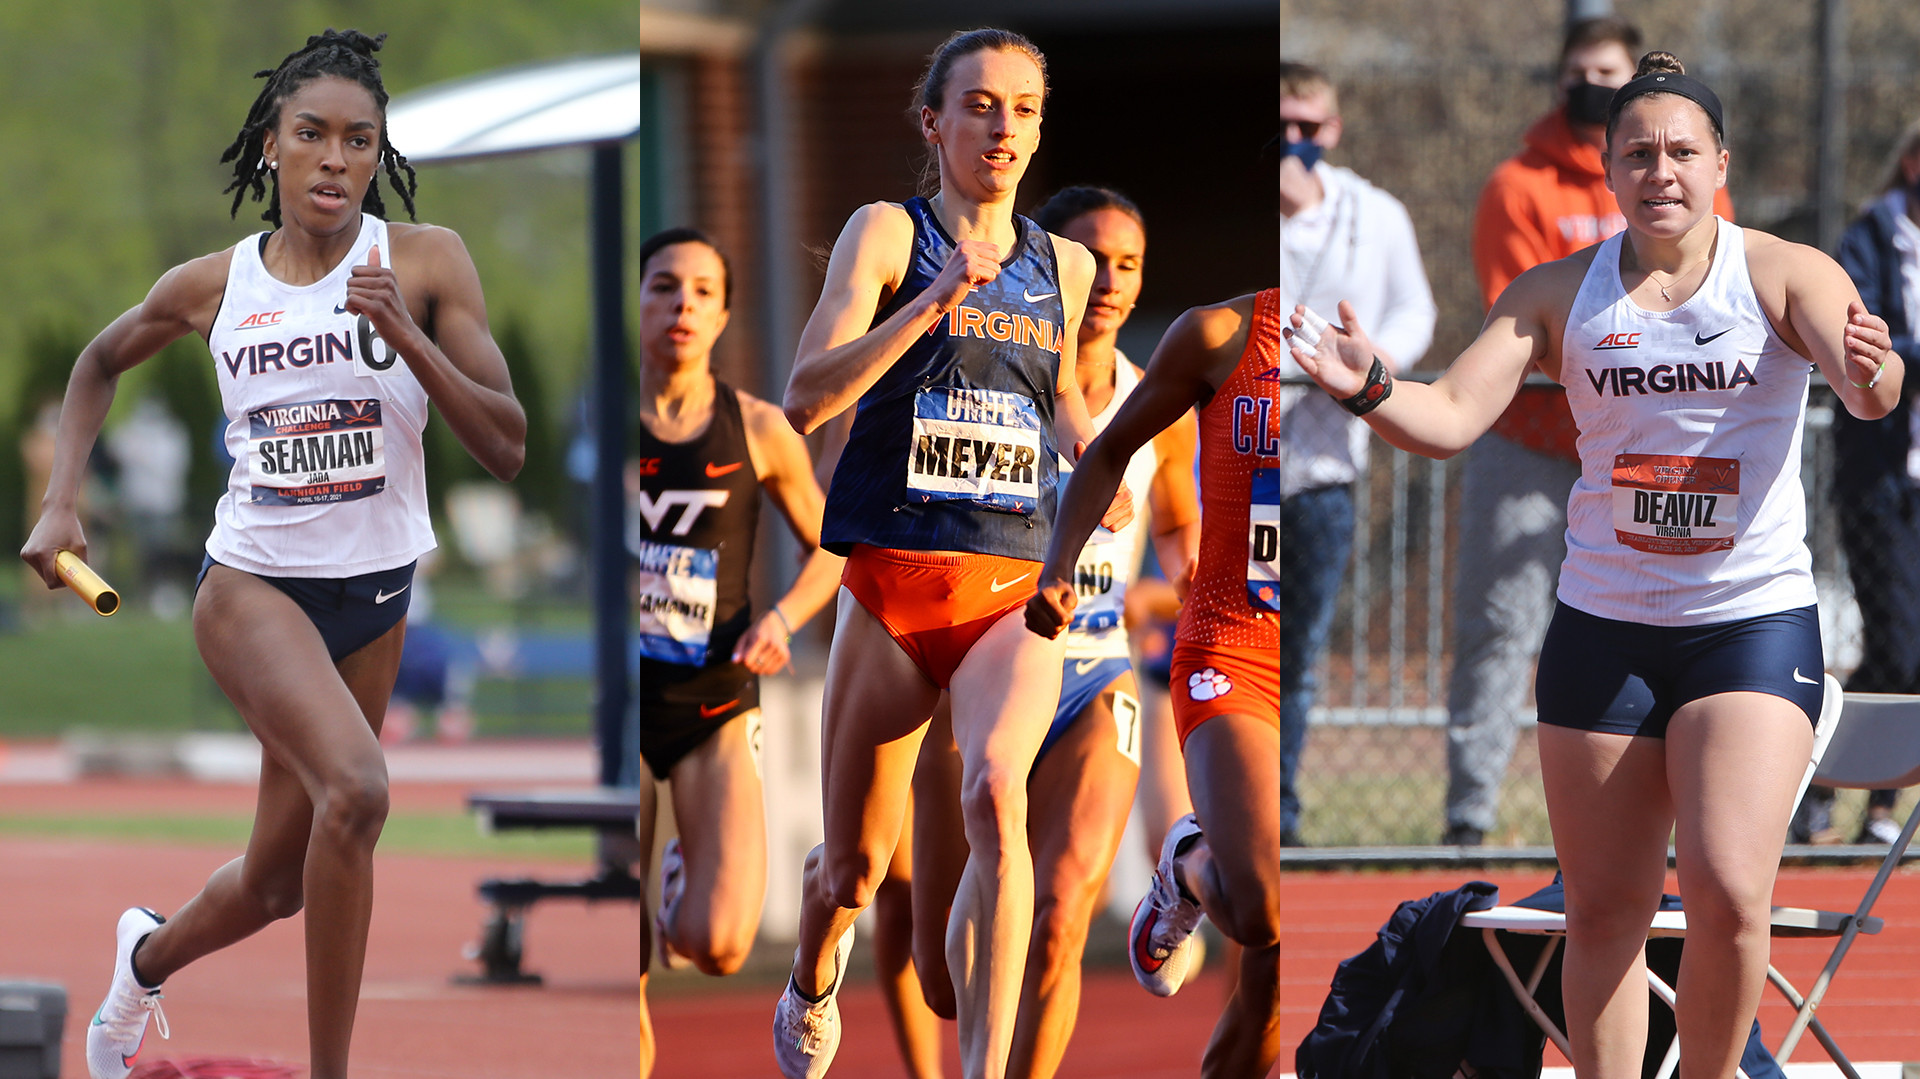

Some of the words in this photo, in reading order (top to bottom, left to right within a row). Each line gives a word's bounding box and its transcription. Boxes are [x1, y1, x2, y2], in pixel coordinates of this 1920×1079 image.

[238, 310, 285, 328] ACC
[357, 314, 397, 371] 6
[1596, 332, 1642, 347] ACC
[1585, 359, 1758, 398] VIRGINIA
[260, 403, 342, 428] VIRGINIA
[946, 389, 1015, 425] UNITE
[275, 422, 331, 435] CHALLENGE
[259, 431, 374, 475] SEAMAN
[914, 434, 1036, 484] MEYER
[307, 472, 330, 485] JADA
[1653, 465, 1700, 475] VIRGINIA
[1654, 474, 1697, 485] OPENER
[277, 485, 330, 497] LANNIGAN
[333, 482, 363, 494] FIELD
[296, 496, 313, 504] APRIL
[330, 493, 342, 502] 2021
[1633, 489, 1717, 528] DEAVIZ
[1655, 525, 1691, 538] VIRGINIA
[1253, 524, 1277, 562] D
[1122, 697, 1136, 753] 7
